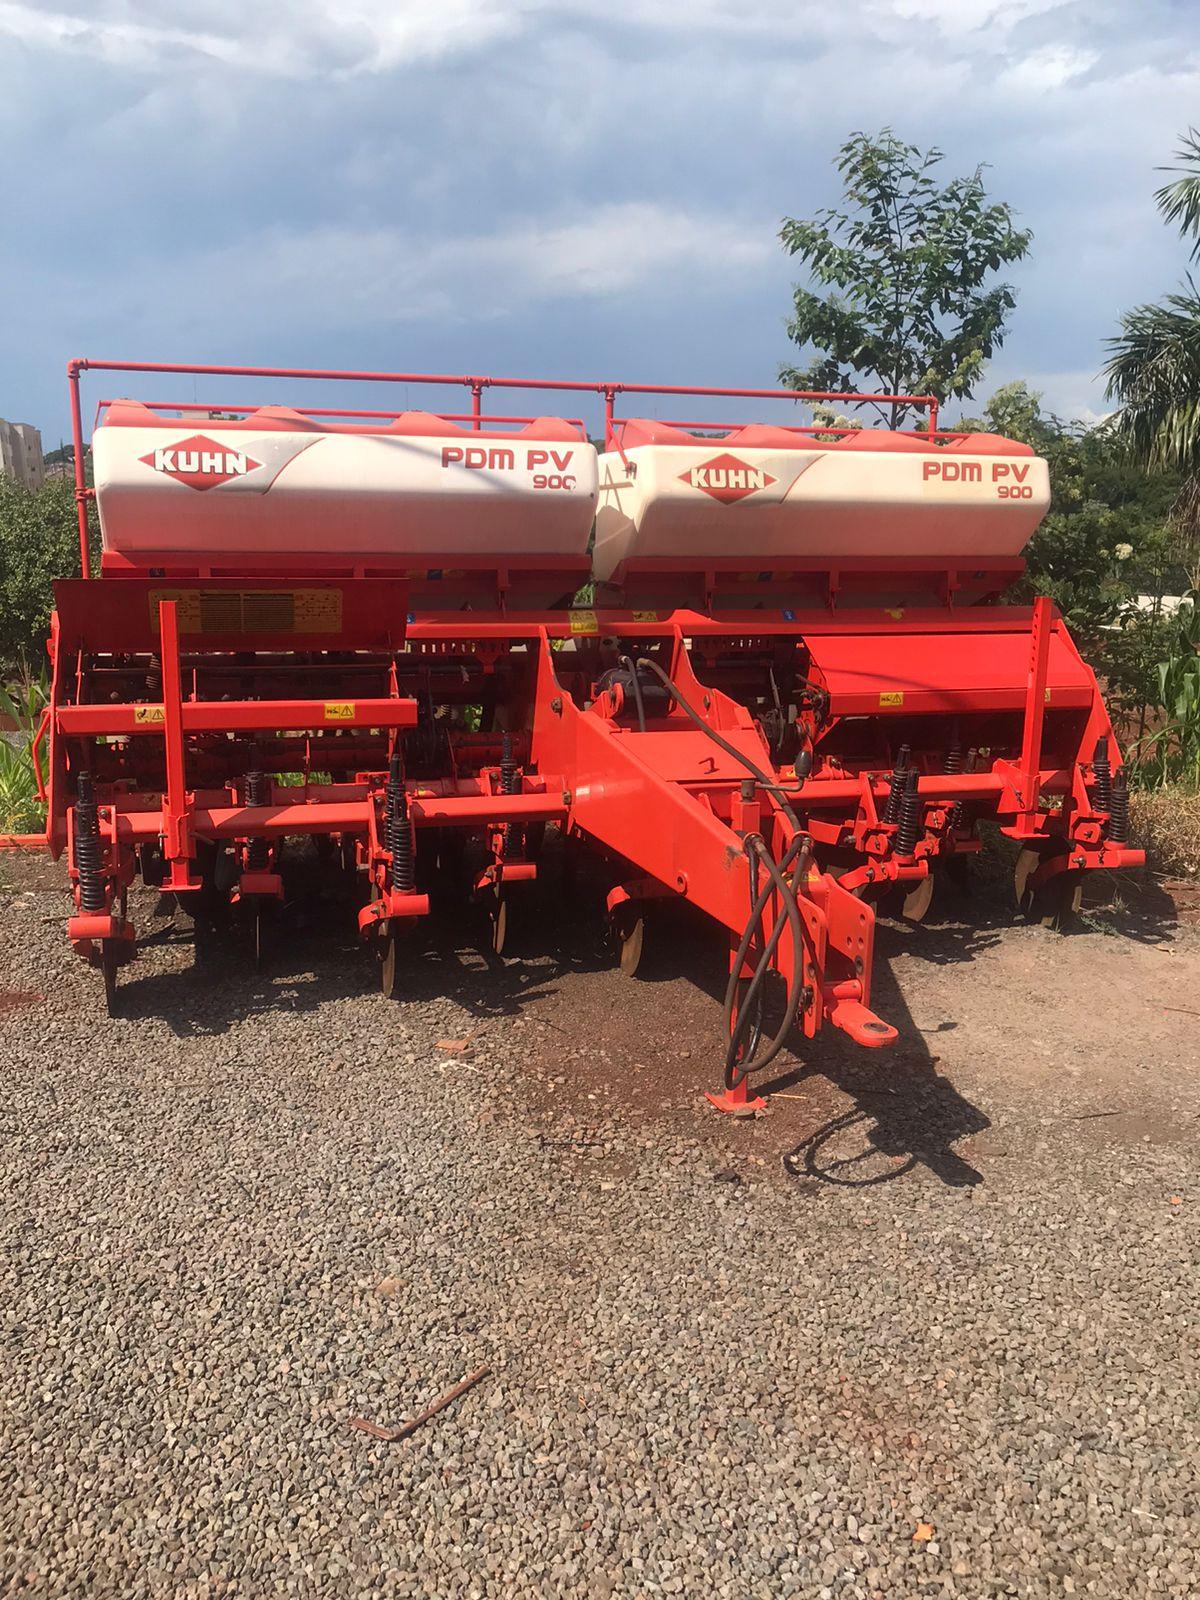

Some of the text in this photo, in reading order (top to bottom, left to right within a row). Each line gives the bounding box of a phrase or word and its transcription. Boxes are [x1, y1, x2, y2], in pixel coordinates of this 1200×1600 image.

[153, 449, 248, 475] KUHN
[441, 447, 574, 471] PDM PV
[690, 468, 765, 489] KUHN
[923, 461, 1030, 482] PDM PV
[997, 485, 1033, 499] 900
